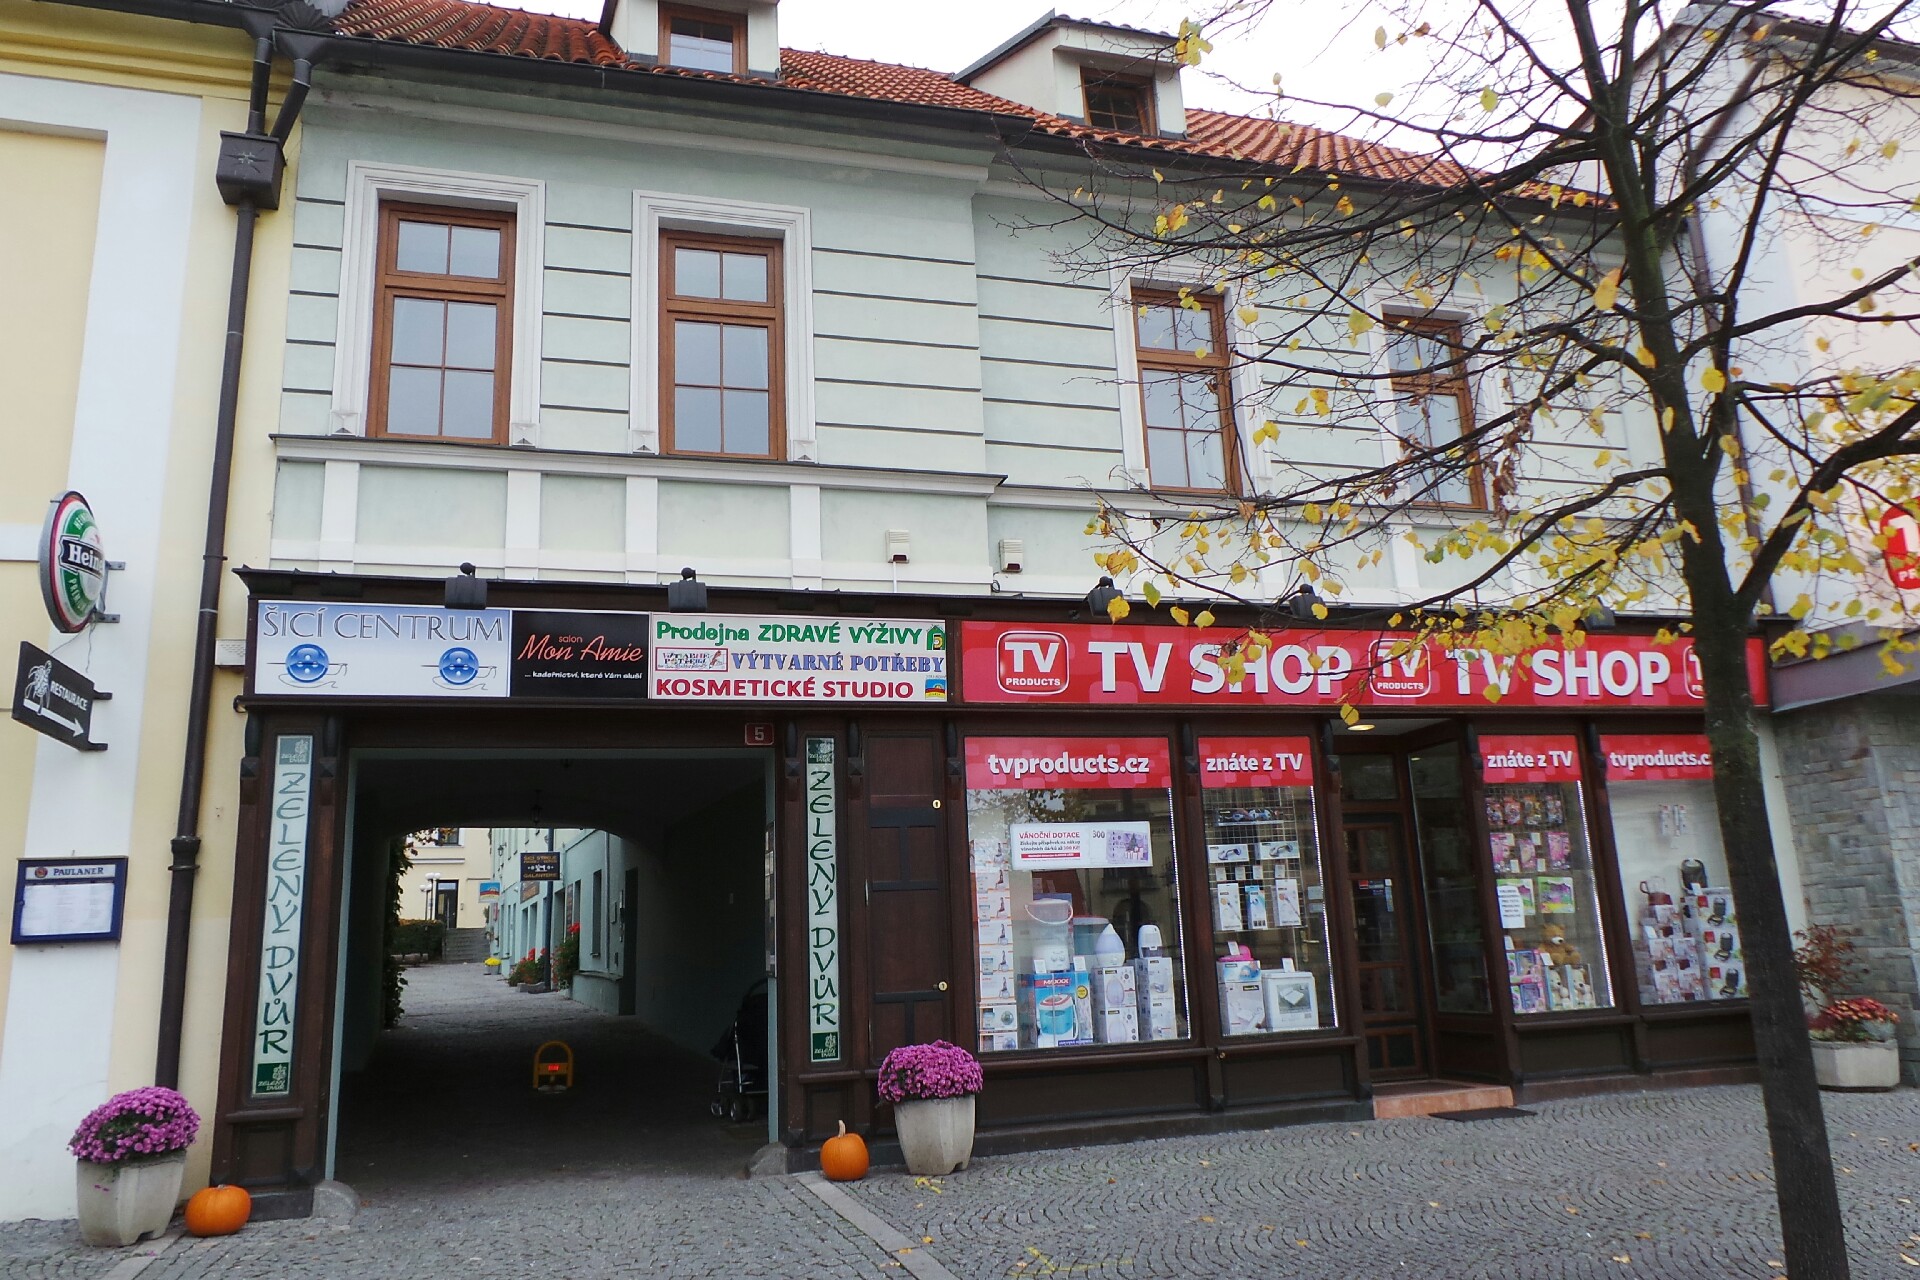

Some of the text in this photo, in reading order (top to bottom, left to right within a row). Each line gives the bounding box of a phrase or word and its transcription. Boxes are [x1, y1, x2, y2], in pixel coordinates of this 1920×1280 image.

[263, 607, 504, 643] ŠICÍ CENTRUM
[656, 622, 923, 646] Prodejna ZDRAVÉ VÝŽIVY
[518, 634, 643, 662] Mon Amie
[559, 635, 583, 643] salon
[731, 650, 945, 673] VÝTVARNÉ POTŘEBY
[1005, 642, 1060, 673] TV
[1088, 642, 1353, 695] TV SHOP
[1377, 649, 1422, 678] TV
[1006, 677, 1061, 687] PRODUCTS
[1377, 682, 1424, 690] PRODUCTS
[1446, 649, 1670, 697] TV SHOP
[50, 681, 88, 711] RESTAURACE
[656, 677, 914, 699] KOSMETICKÉ STUDIO
[754, 727, 765, 742] 5
[988, 751, 1150, 779] tvproducts.cz
[1206, 754, 1304, 773] znáte z TV
[1488, 751, 1573, 768] znáte z TV
[1610, 750, 1712, 771] tvproducts.c
[810, 771, 836, 916] ZELENÝ
[1093, 830, 1106, 839] 300
[268, 772, 307, 934] ZELENÝ
[53, 867, 104, 876] PAULANER
[811, 927, 837, 1026] DVŮR
[259, 946, 296, 1055] DVŮR
